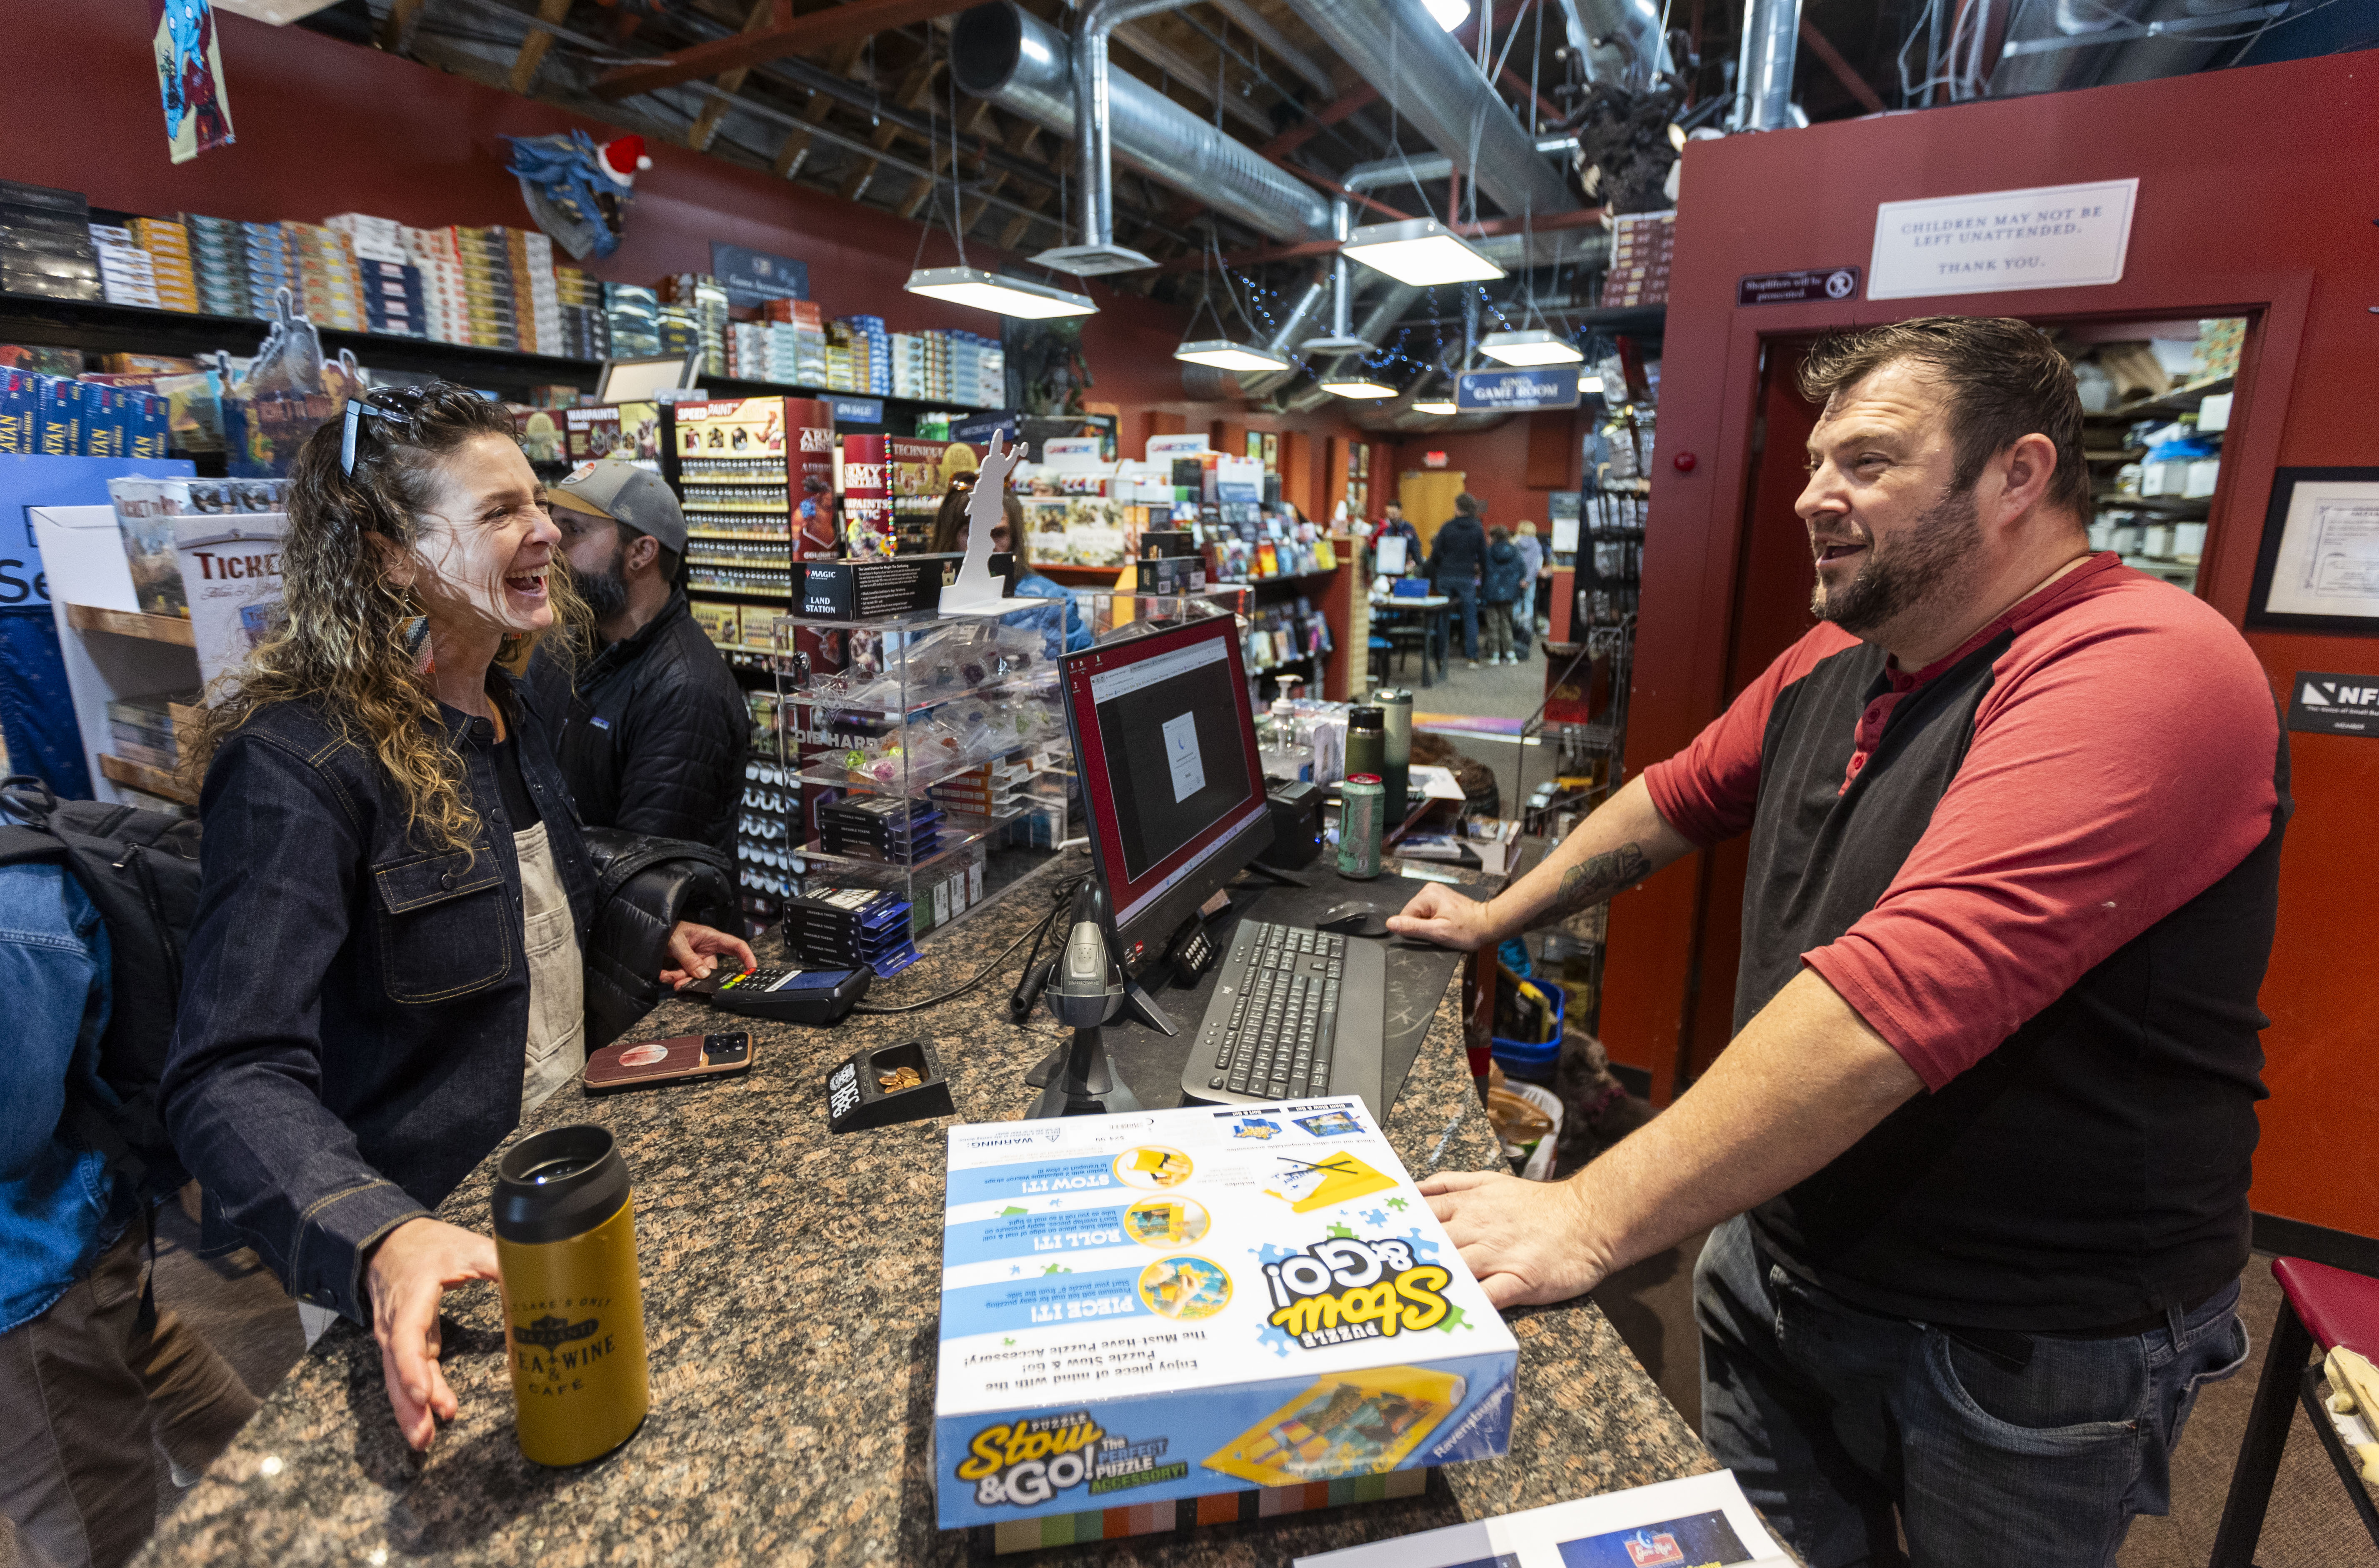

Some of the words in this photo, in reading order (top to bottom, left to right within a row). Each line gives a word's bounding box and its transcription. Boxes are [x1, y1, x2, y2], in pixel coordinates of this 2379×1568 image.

[1901, 218, 1986, 235] CHILDREN
[1994, 213, 2030, 226] MAY
[2036, 210, 2072, 223] NOT
[2081, 206, 2103, 218] BE
[1914, 235, 1953, 247] LEFT
[1960, 223, 2081, 243] UNATTENDED.
[1938, 258, 1996, 275] THANK
[2004, 256, 2045, 270] YOU.
[678, 408, 708, 420] SPEED
[46, 421, 65, 455] ATAN
[192, 552, 279, 580] TICKE
[811, 596, 830, 605] LAND
[806, 604, 836, 614] STATION
[2337, 686, 2379, 705] NF
[843, 1079, 860, 1109] DCC
[967, 1138, 1033, 1148] WARNING:
[1070, 1163, 1098, 1172] transport
[1031, 1172, 1063, 1180] adjustable
[1051, 1174, 1109, 1191] STOW
[1021, 1180, 1048, 1193] IT!
[995, 1224, 1026, 1233] pressure
[1033, 1235, 1062, 1251] IT!
[1066, 1228, 1121, 1247] ROLL
[1068, 1283, 1092, 1292] puzzle
[1094, 1281, 1110, 1289] your
[1098, 1288, 1131, 1296] Premium
[579, 1298, 612, 1308] ONLY
[1066, 1295, 1136, 1319] PIECE
[1272, 1266, 1448, 1337] Stow
[1031, 1302, 1063, 1323] IT!
[1101, 1332, 1178, 1350] Must-Have
[1181, 1329, 1208, 1342] The
[1301, 1321, 1379, 1348] PUZZLE
[519, 1352, 543, 1373] EA
[562, 1333, 615, 1370] WINE
[1049, 1342, 1096, 1355] Puzzle
[963, 1348, 1045, 1368] Accessory!
[1067, 1355, 1103, 1368] Stow
[1108, 1350, 1155, 1363] Puzzle
[1021, 1362, 1046, 1373] Go!
[1051, 1360, 1061, 1370] &
[1114, 1362, 1153, 1377] piece
[1158, 1358, 1198, 1372] Enjoy
[1053, 1372, 1090, 1384] mind
[1095, 1369, 1109, 1381] of
[985, 1381, 1009, 1393] the
[1015, 1376, 1048, 1390] with
[1031, 1413, 1088, 1433] PUZZLE
[958, 1419, 1105, 1480] Stow
[1101, 1438, 1126, 1450] The
[1098, 1440, 1168, 1463] PERFECT
[1096, 1457, 1154, 1480] PUZZLE
[1090, 1463, 1187, 1495] ACCESSORY!
[1635, 1545, 1655, 1562] Game
[1654, 1541, 1673, 1556] Night
